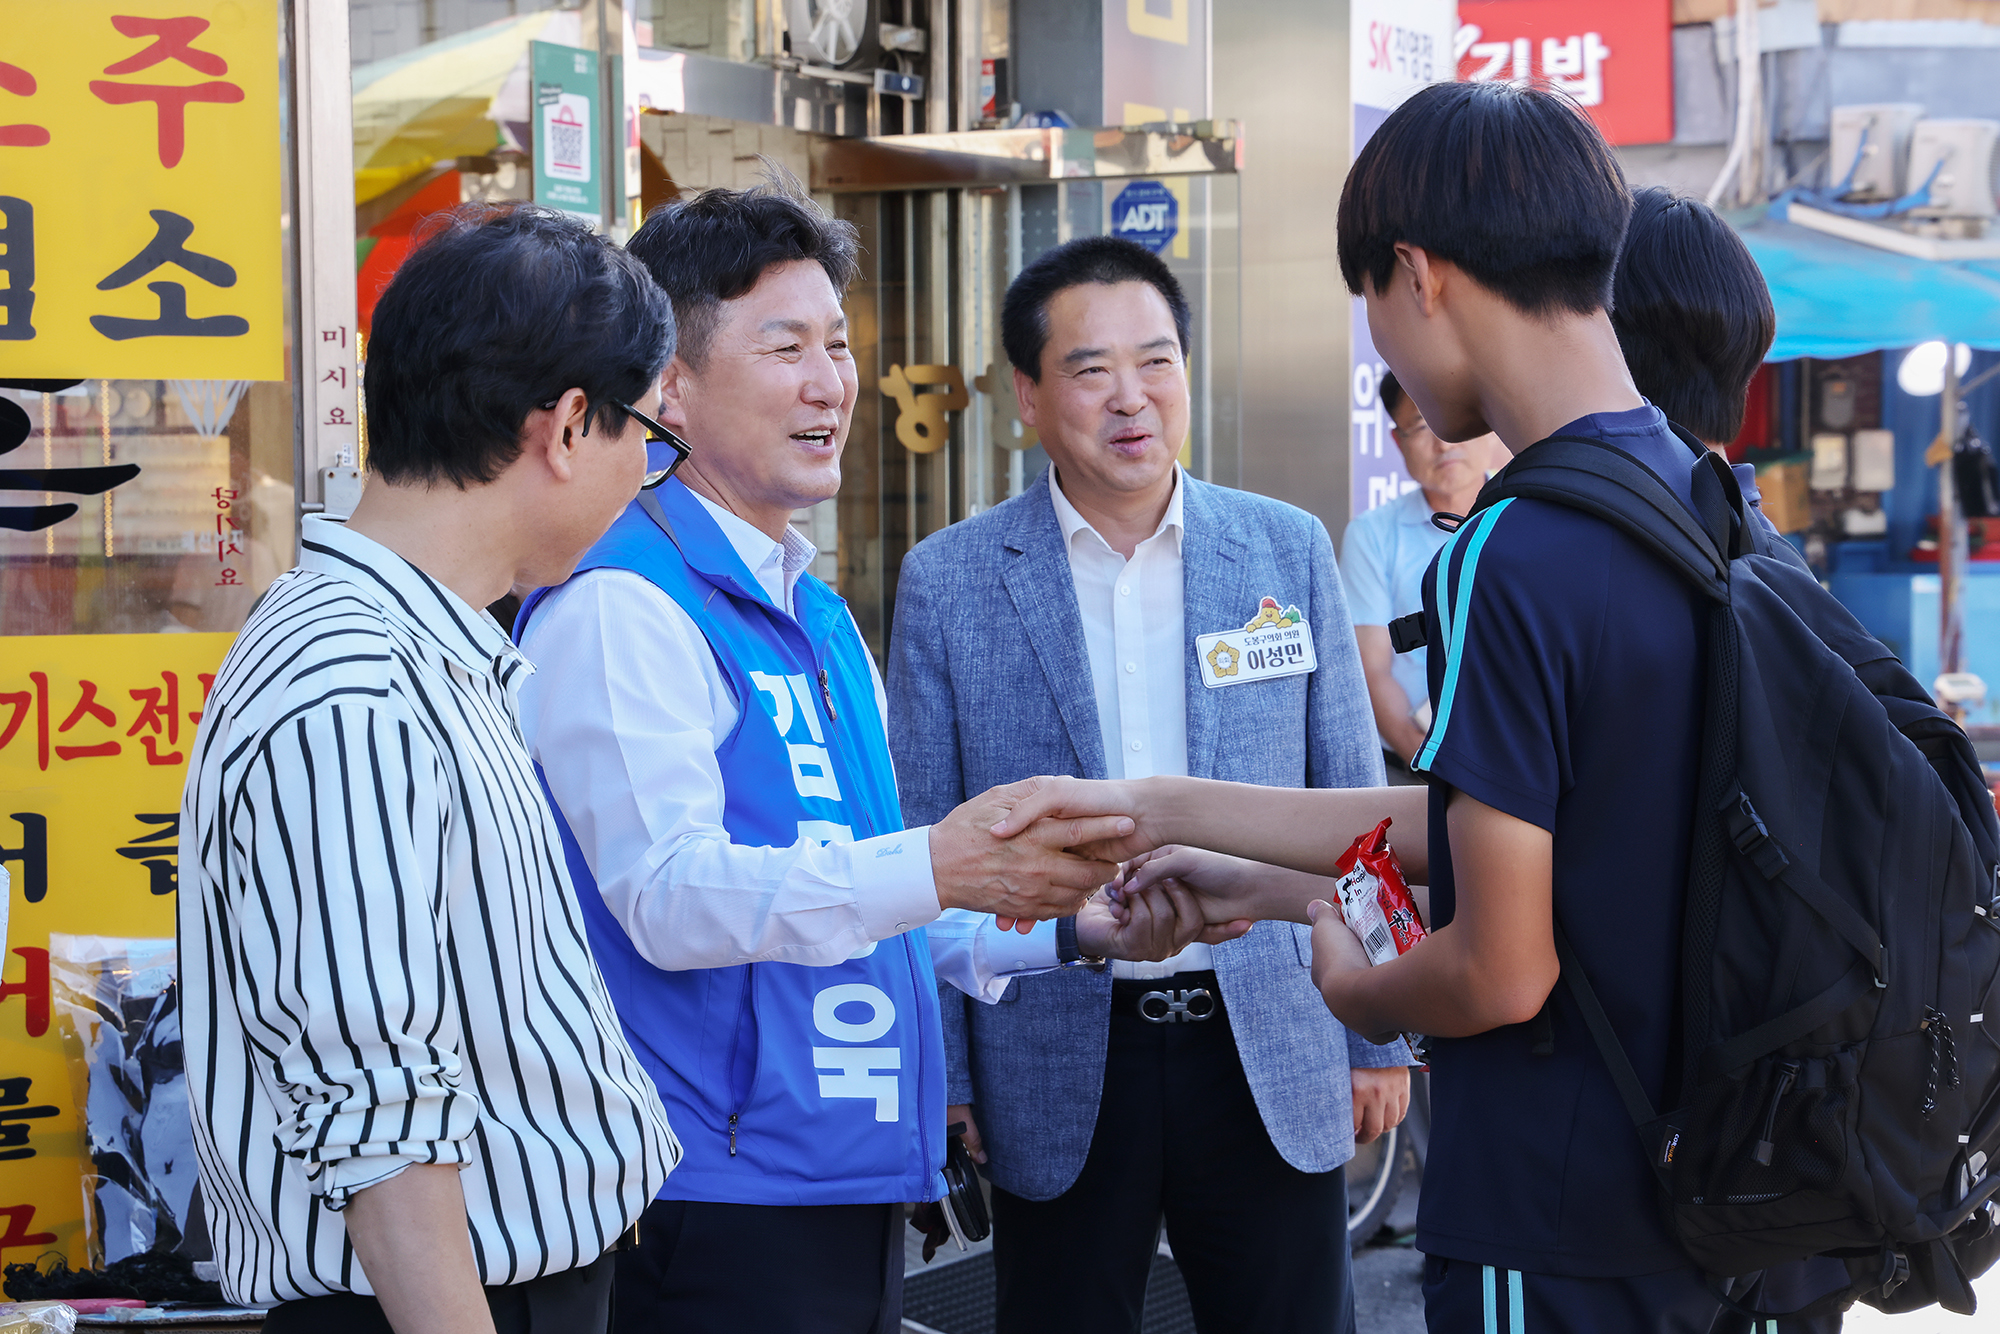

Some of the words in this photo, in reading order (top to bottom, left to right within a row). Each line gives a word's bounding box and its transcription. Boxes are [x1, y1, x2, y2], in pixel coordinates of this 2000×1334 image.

[0, 15, 245, 169] 주
[1120, 203, 1169, 232] ADT
[322, 326, 352, 425] 미시요
[1244, 632, 1283, 646] 도봉구의회
[1284, 629, 1300, 640] 의원
[1247, 642, 1305, 670] 이성민
[0, 670, 217, 772] 기스전
[750, 670, 902, 1122] 김욱
